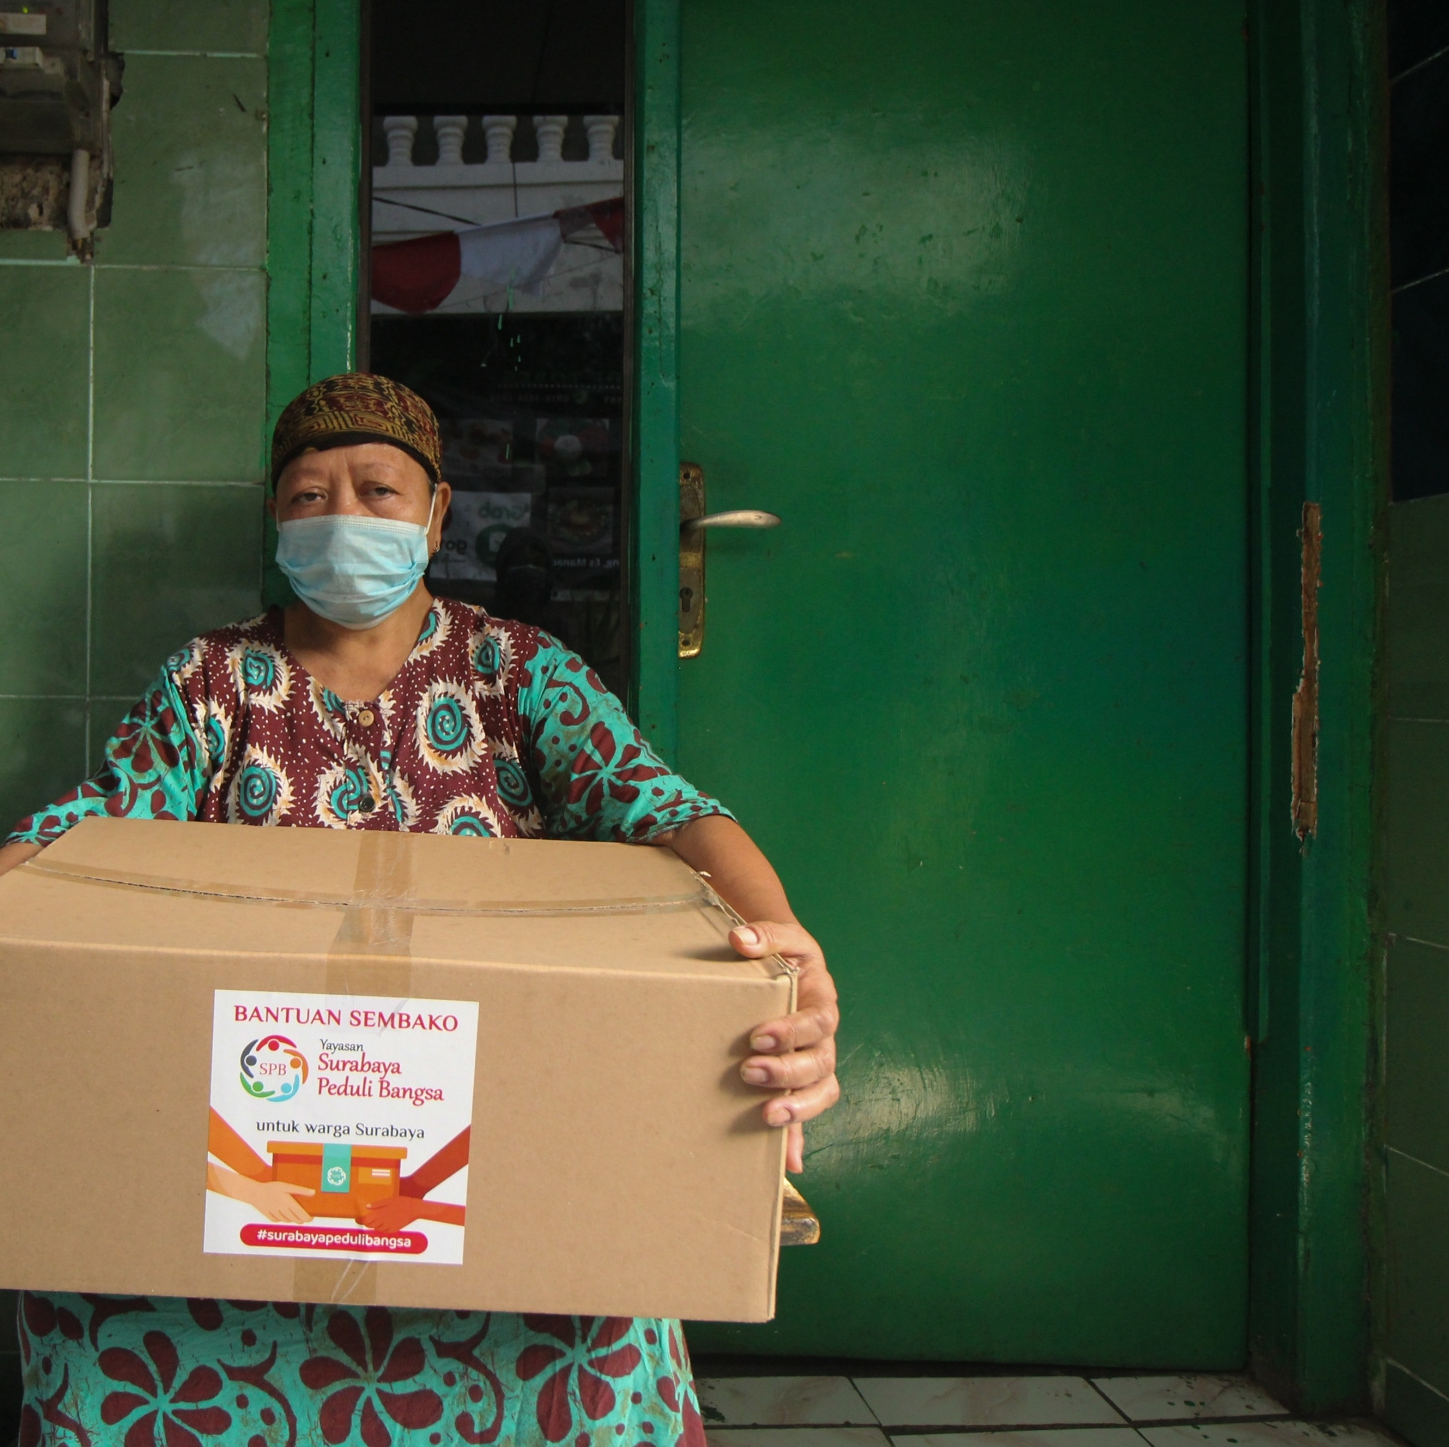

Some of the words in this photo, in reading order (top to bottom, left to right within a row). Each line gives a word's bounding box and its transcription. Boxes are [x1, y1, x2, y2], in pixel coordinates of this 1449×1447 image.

[234, 1005, 341, 1026] BANTUAN
[349, 1010, 458, 1032] SEMBAKO
[320, 1039, 364, 1053] Yayasan
[259, 1063, 286, 1076] SPB
[318, 1052, 402, 1080] Surabaya
[317, 1077, 373, 1097] Peduli
[378, 1080, 444, 1106] Bangsa
[256, 1120, 299, 1133] untuk
[305, 1124, 350, 1138] warga
[356, 1123, 425, 1141] Surabaya
[257, 1229, 411, 1249] #surabayapedulibangsa
